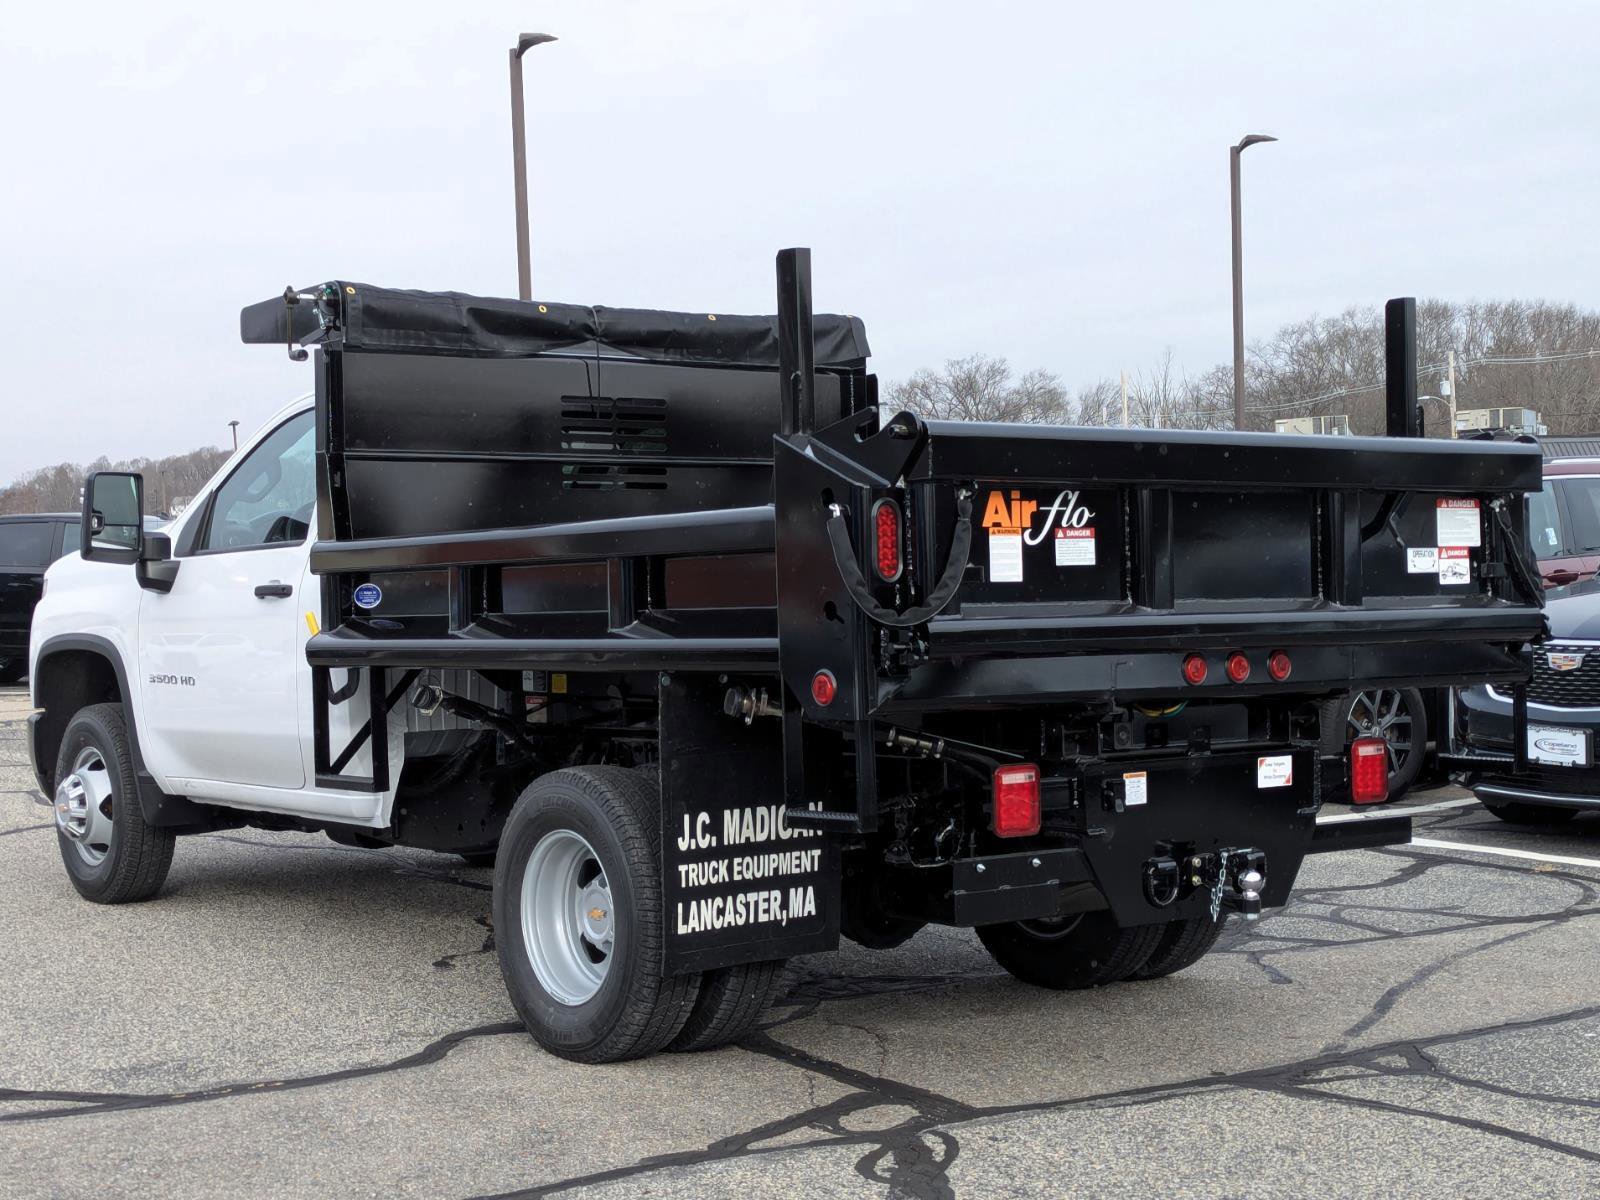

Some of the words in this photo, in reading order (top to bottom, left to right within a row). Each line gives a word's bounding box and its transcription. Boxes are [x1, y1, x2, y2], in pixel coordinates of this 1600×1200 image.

[1448, 500, 1476, 508] DANGER
[982, 490, 1037, 528] Air
[1023, 490, 1096, 546] flo
[1066, 529, 1091, 537] DANGER
[149, 674, 178, 684] 3500
[180, 676, 195, 686] HD
[677, 811, 717, 851] J.C.
[723, 801, 823, 846] MADI
[678, 859, 729, 888] TRUCK
[733, 849, 822, 881] EQUIPMENT
